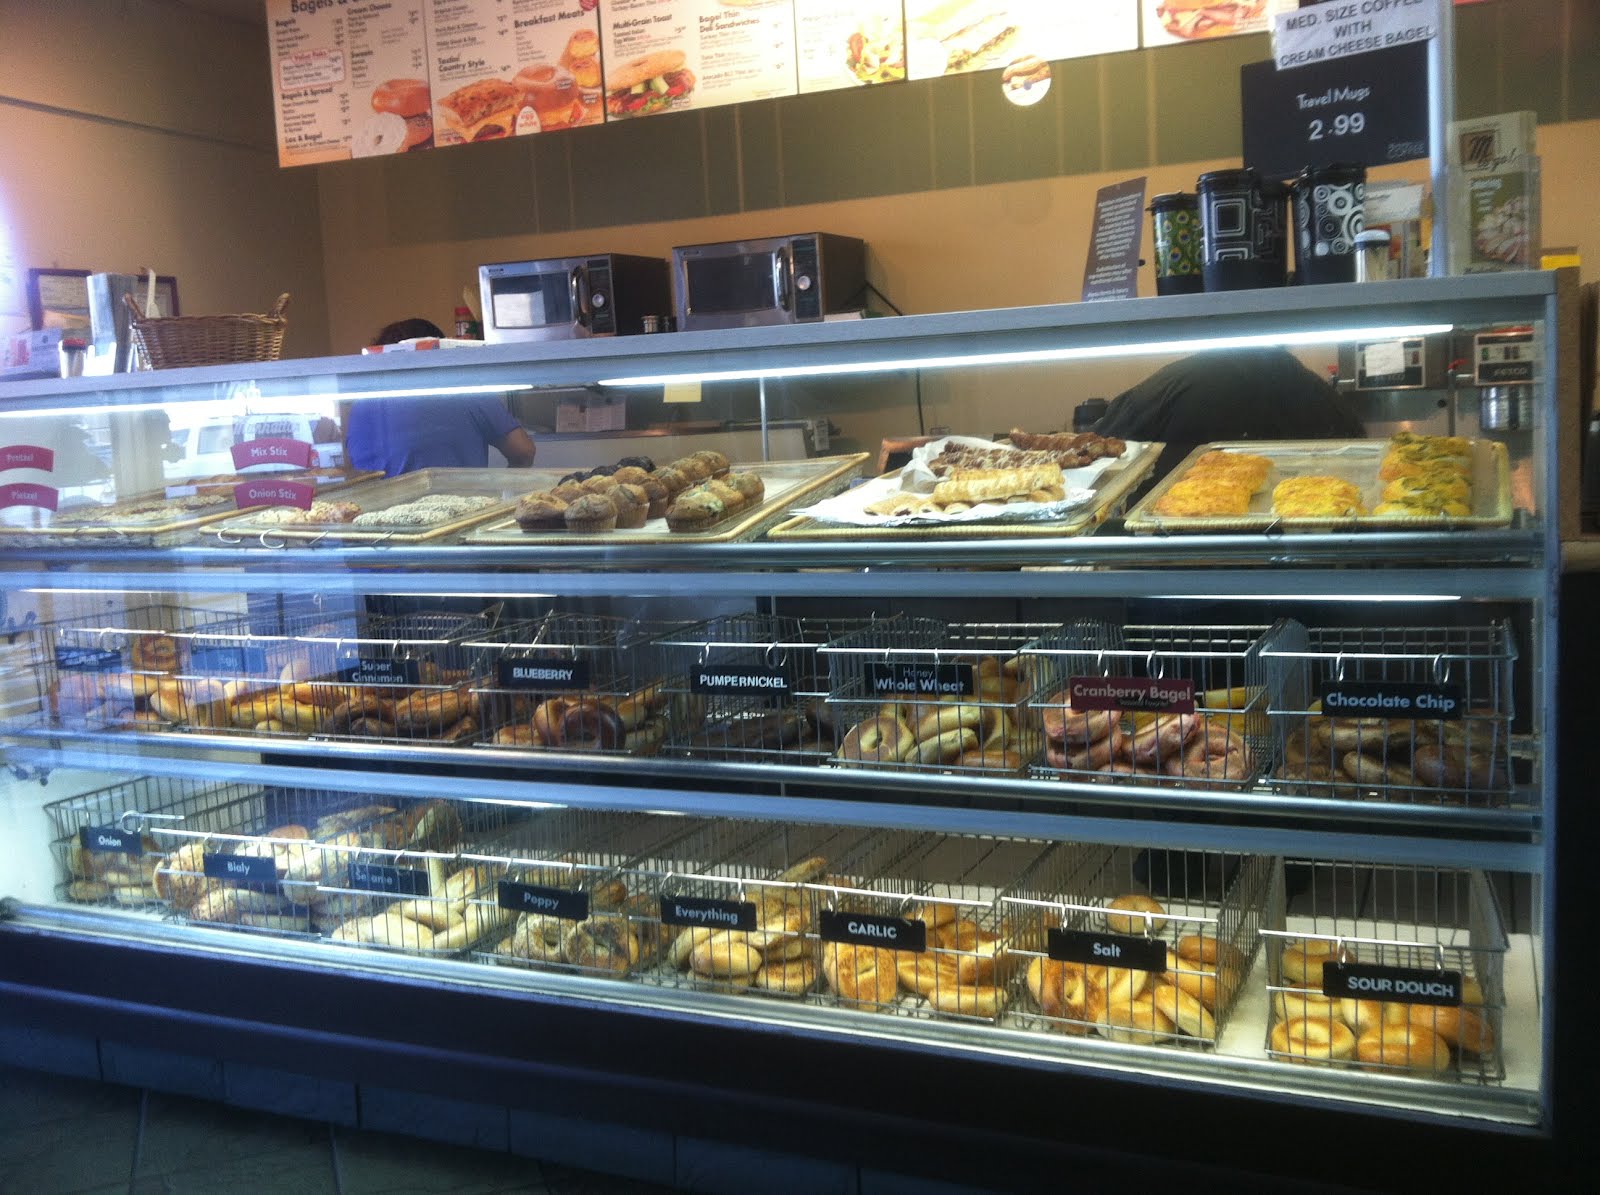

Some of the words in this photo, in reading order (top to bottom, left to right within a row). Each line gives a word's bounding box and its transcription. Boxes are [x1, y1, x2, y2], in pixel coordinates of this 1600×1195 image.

[514, 15, 557, 29] Breakfast
[558, 10, 585, 20] Meats
[612, 18, 652, 30] Multi-Grain
[653, 13, 673, 23] Toast
[1286, 13, 1322, 31] MED.
[1326, 6, 1358, 23] SIZE
[1361, 0, 1423, 14] COFF
[699, 22, 714, 33] Deli
[715, 18, 760, 30] Sandwiches
[1333, 19, 1372, 39] WITH
[1280, 47, 1326, 67] CREAM
[1328, 36, 1383, 56] CHEESE
[1385, 25, 1435, 44] BAGEL
[439, 62, 467, 73] Country
[467, 58, 486, 69] Style
[1296, 88, 1333, 110] Travel
[1333, 85, 1373, 103] Mugs
[1308, 112, 1366, 140] 2.99
[251, 448, 268, 458] Mix
[269, 446, 288, 456] Stix
[248, 488, 277, 499] Onion
[279, 488, 297, 500] Stix
[352, 671, 404, 683] Cinnamon
[512, 667, 574, 681] BLUEBERRY
[699, 674, 788, 689] PUMPERNICKEL
[903, 667, 933, 679] Honey
[875, 678, 915, 691] Whole
[919, 678, 965, 692] Wheat
[1073, 683, 1147, 701] Cranberry
[1149, 686, 1191, 703] Bagel
[1326, 692, 1411, 708] Chocolate
[1415, 694, 1456, 712] Chip
[98, 834, 122, 847] Onion
[227, 860, 250, 876] Bialy
[355, 866, 393, 885] Seame
[523, 892, 560, 910] Poppy
[675, 905, 738, 925] Everything
[847, 921, 897, 939] GARLIC
[1093, 941, 1121, 958] Salt
[1347, 976, 1393, 992] SOUR
[1395, 980, 1454, 997] DOUGH
